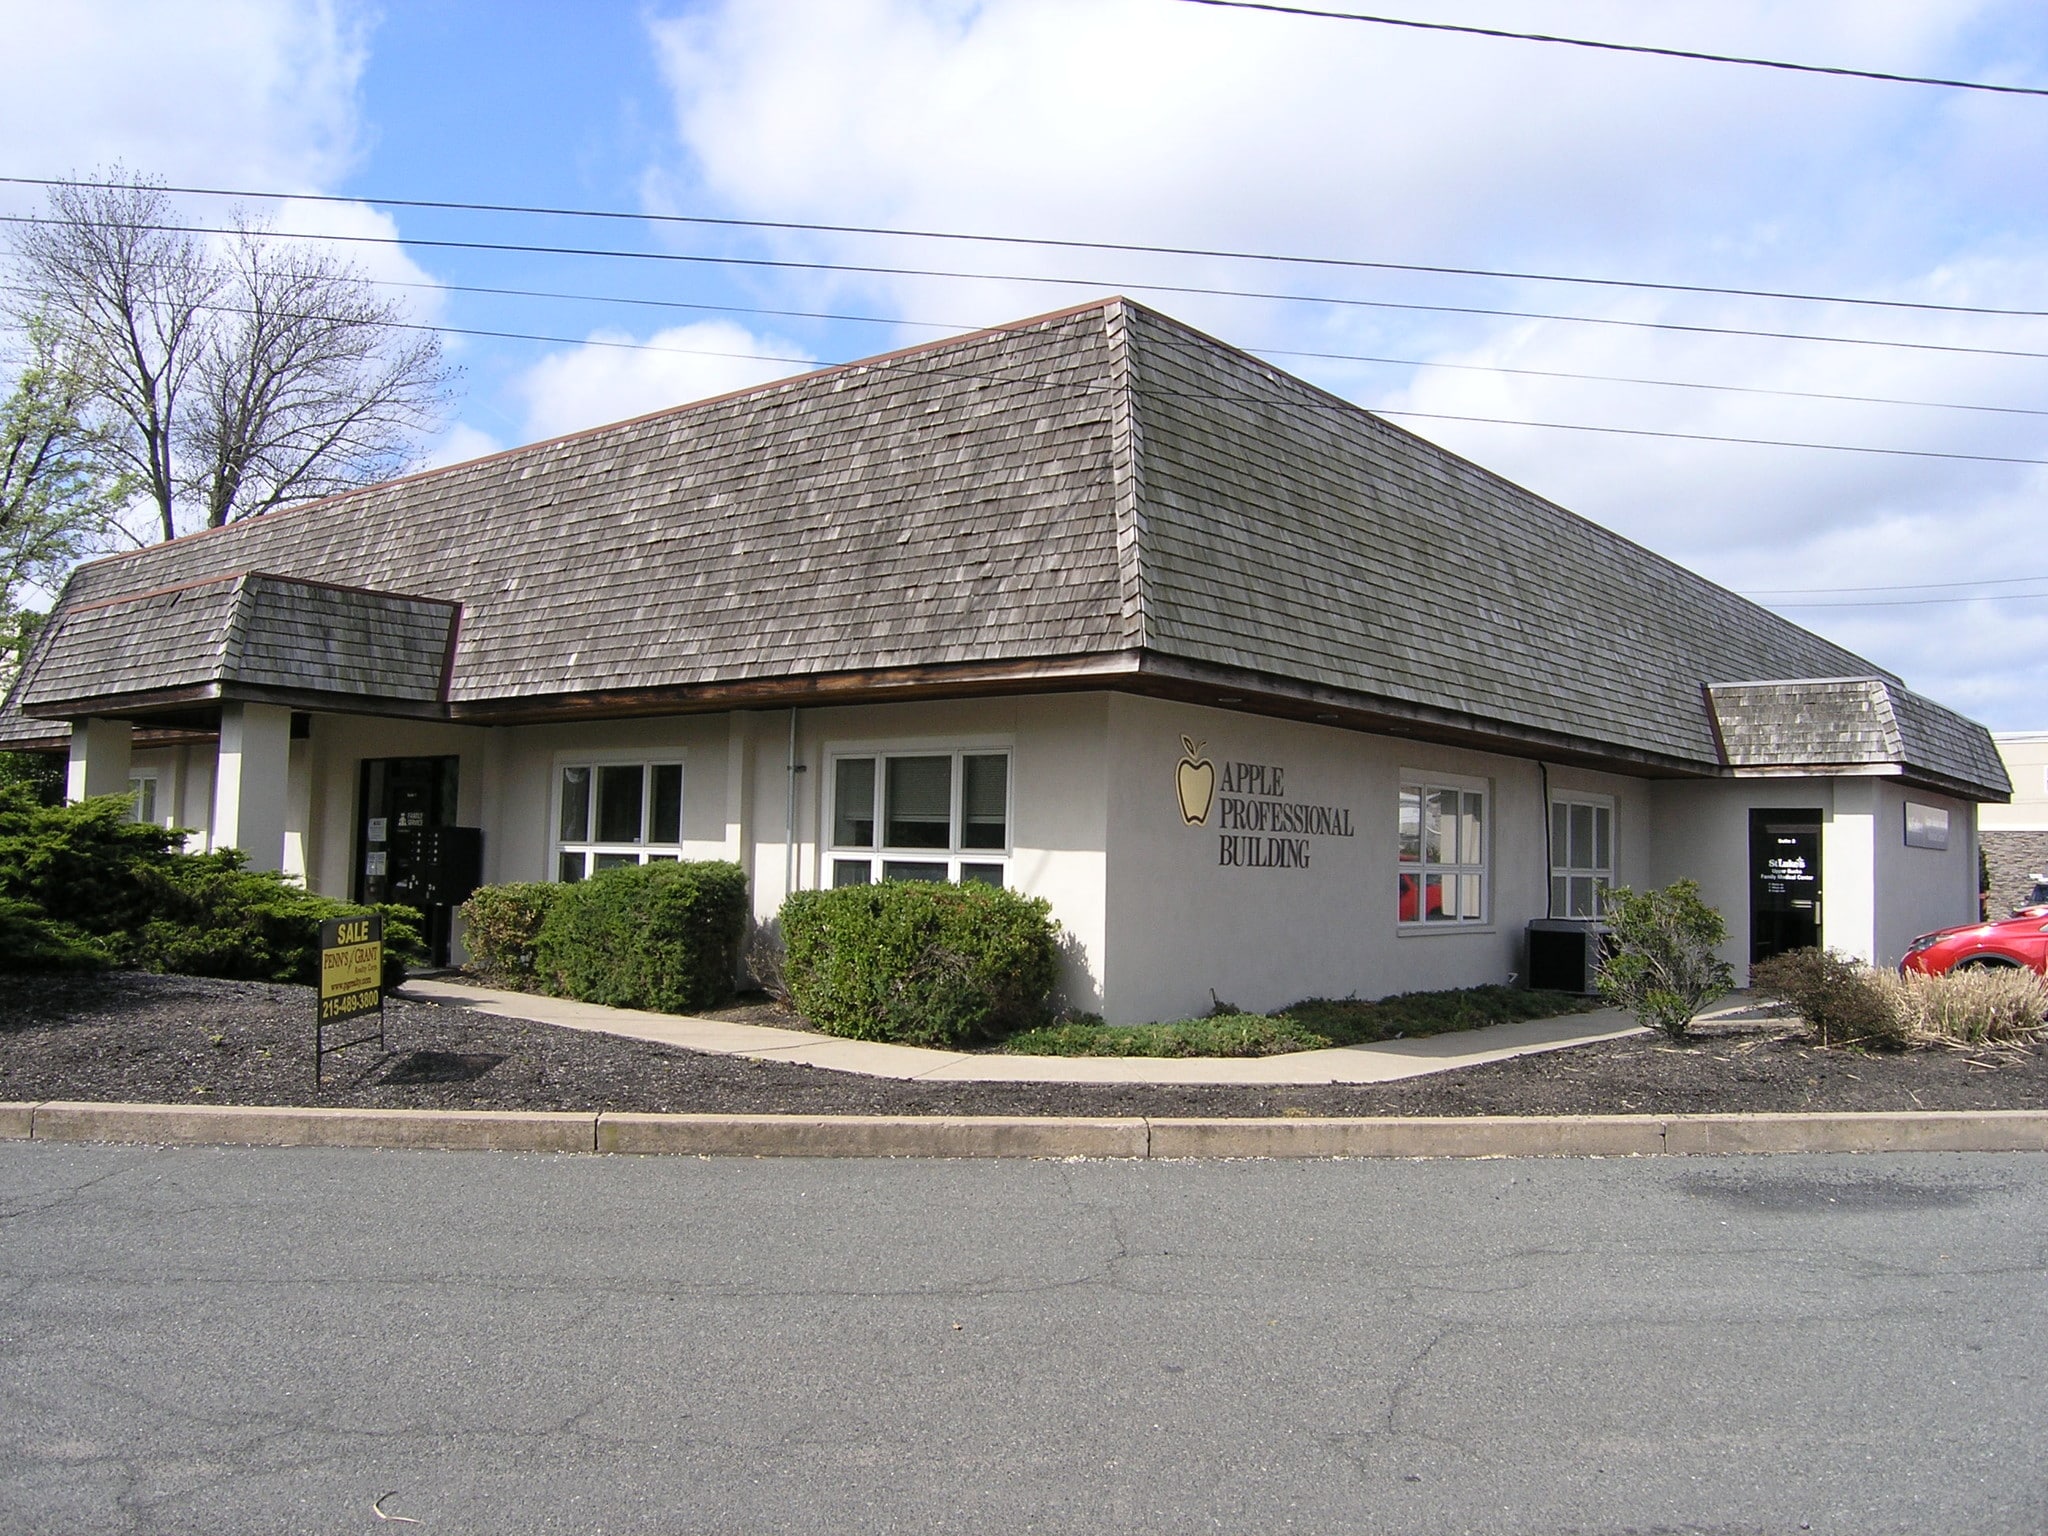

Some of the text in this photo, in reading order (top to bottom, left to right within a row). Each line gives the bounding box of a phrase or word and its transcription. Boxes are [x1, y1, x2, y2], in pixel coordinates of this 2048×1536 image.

[1220, 761, 1284, 796] APPLE
[1219, 797, 1354, 837] PROFESSIONAL
[1219, 834, 1310, 868] BUILDING
[337, 921, 369, 945] SALE
[322, 990, 379, 1018] 215-489-3800
